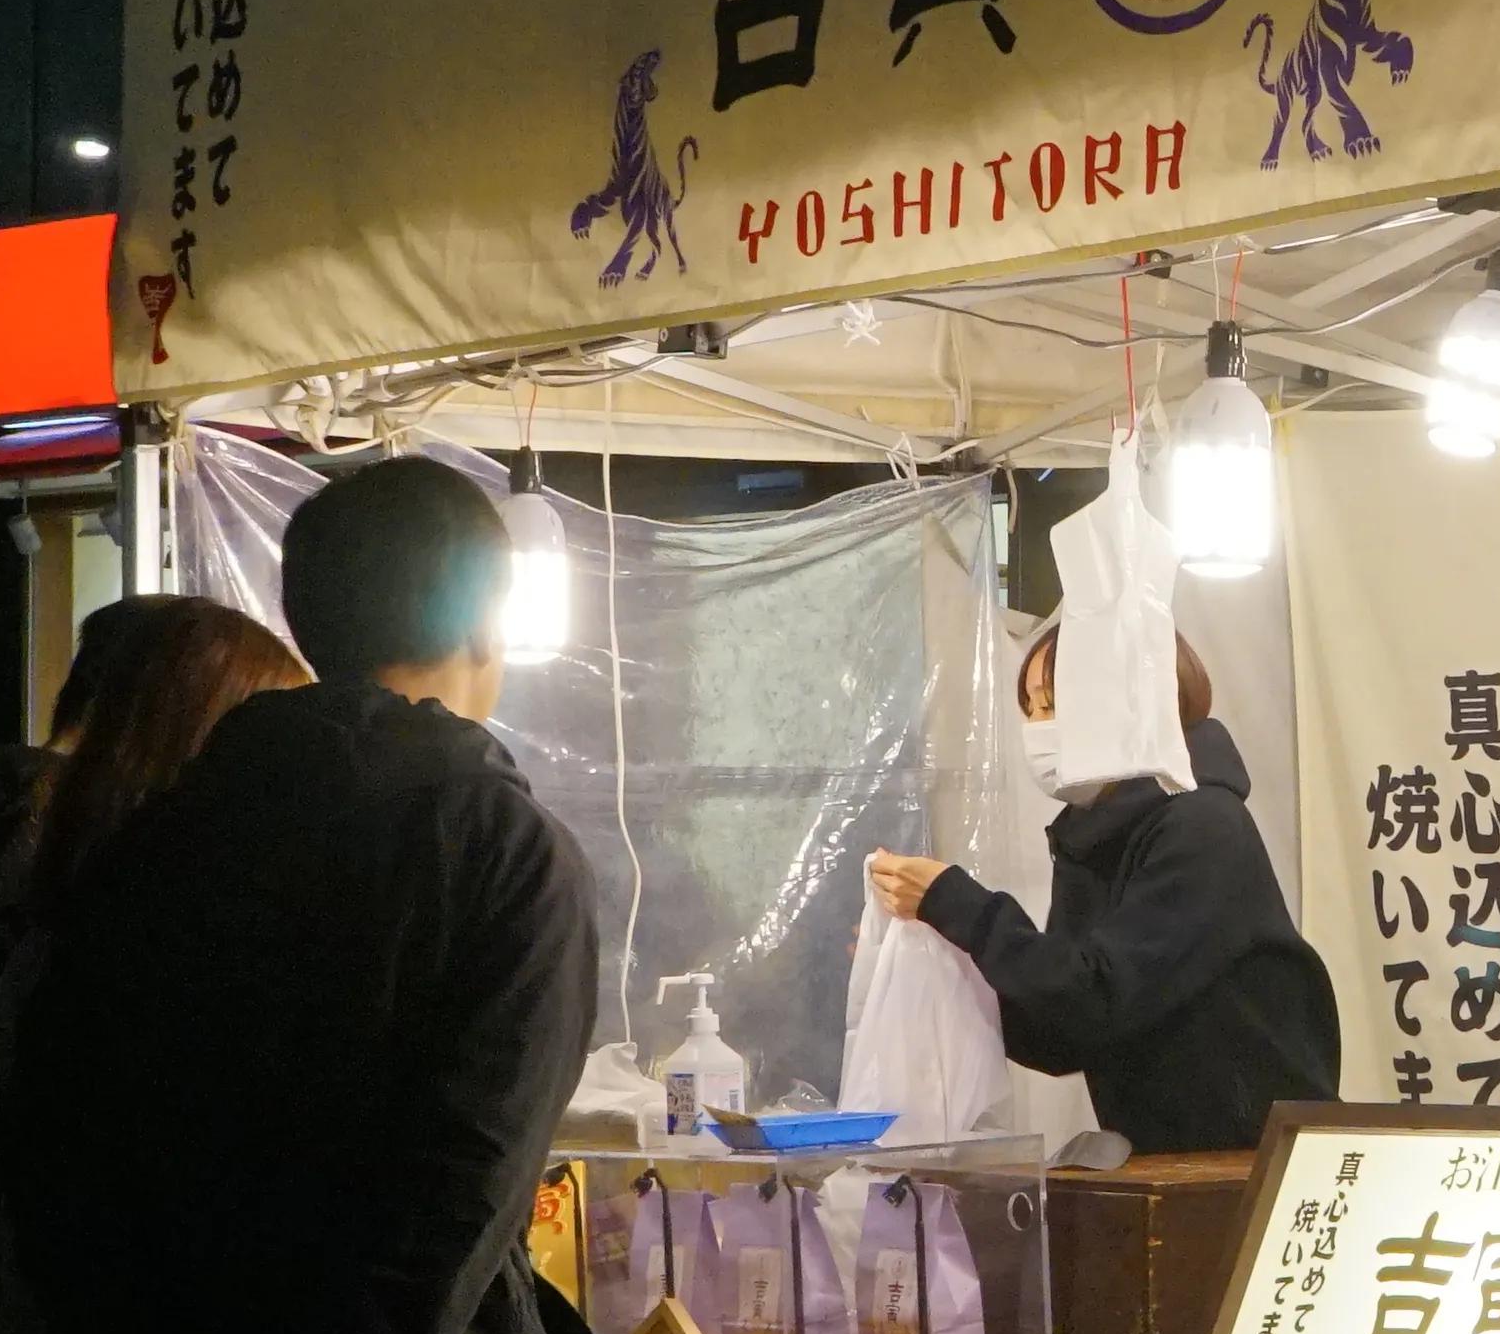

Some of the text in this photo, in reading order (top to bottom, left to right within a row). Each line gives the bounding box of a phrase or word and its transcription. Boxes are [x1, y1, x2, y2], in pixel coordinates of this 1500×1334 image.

[738, 120, 1187, 266] YOSHITORA
[1292, 1151, 1364, 1334] 真心込めて
